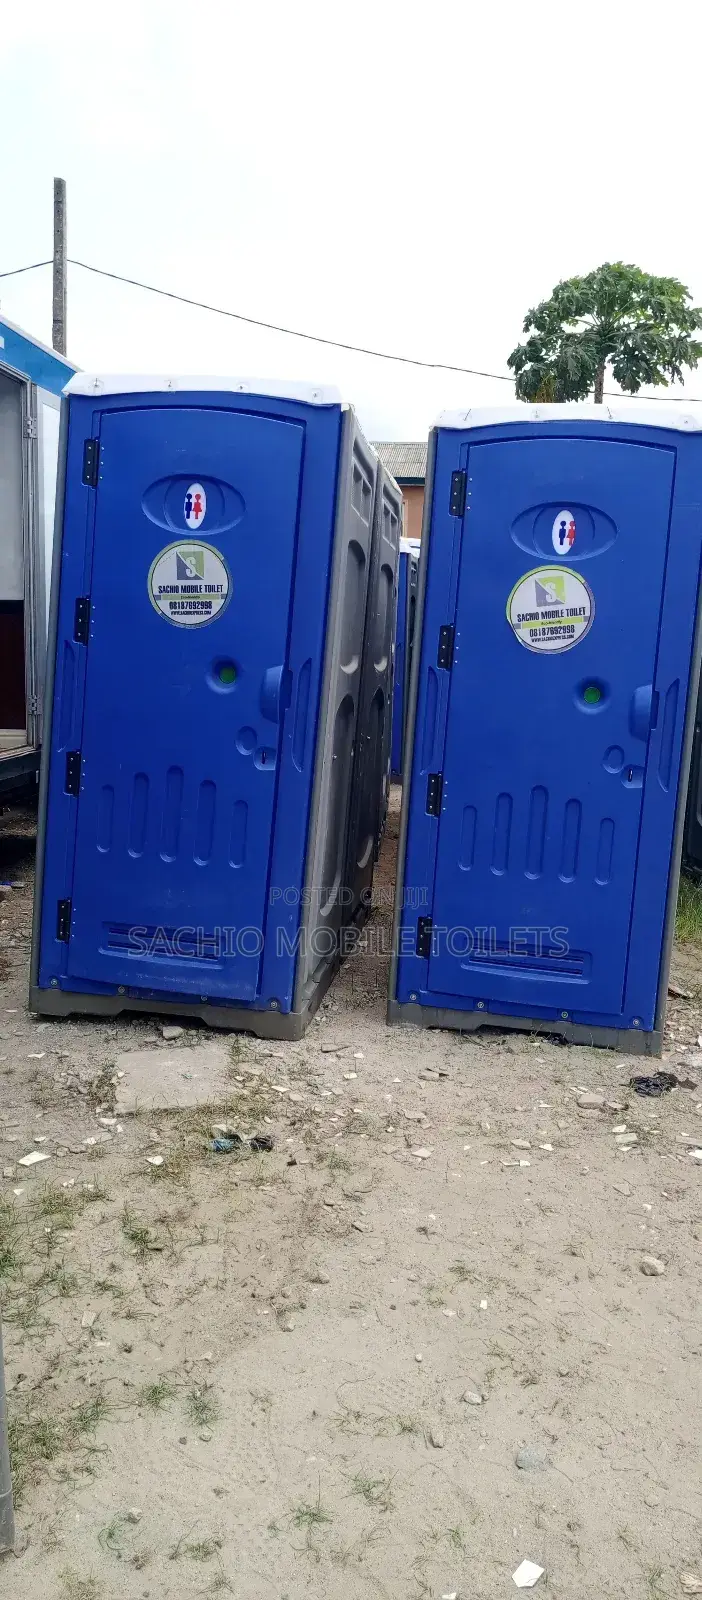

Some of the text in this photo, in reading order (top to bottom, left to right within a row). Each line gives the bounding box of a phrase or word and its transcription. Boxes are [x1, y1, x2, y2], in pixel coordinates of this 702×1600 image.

[158, 584, 223, 594] SACHIO MOBILE TOILET
[169, 601, 212, 610] 08187692998
[517, 607, 586, 623] SACHIO MOBILE TOILET
[529, 625, 575, 638] 08187692998
